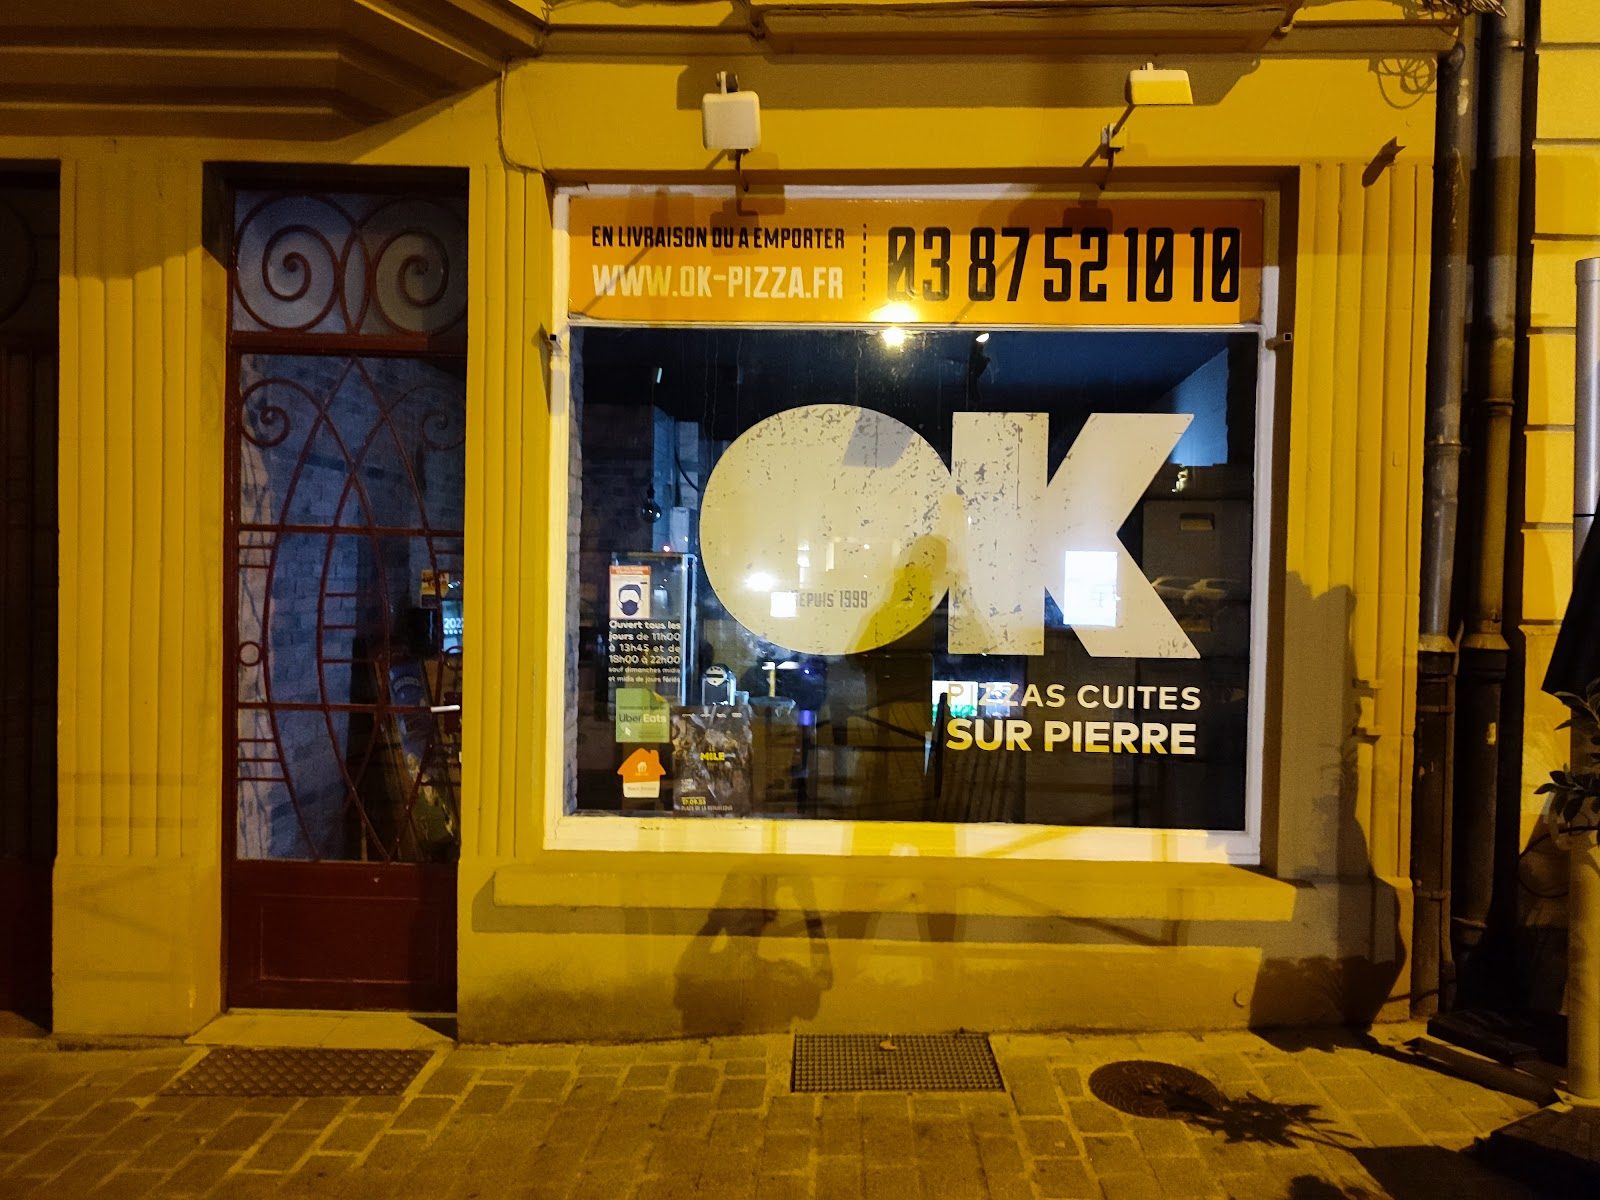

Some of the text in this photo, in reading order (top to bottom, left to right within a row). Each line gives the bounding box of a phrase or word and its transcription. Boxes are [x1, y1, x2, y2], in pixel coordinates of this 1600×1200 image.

[592, 225, 845, 249] EN LIVRAISON OU A EMPORTER
[887, 227, 1241, 302] 03 87 52 10 10
[592, 264, 843, 299] WWW.OK-PIZZA.FR
[699, 404, 1201, 659] OK
[839, 590, 868, 608] 1999
[608, 620, 644, 629] Ouvert
[644, 621, 667, 630] tous
[608, 631, 681, 642] jours de 11h00
[652, 643, 665, 653] et
[649, 655, 681, 665] 22h00
[946, 683, 1202, 711] PIZZAS CUITES
[642, 713, 668, 723] Eats
[945, 718, 1197, 755] SUR PIERRE
